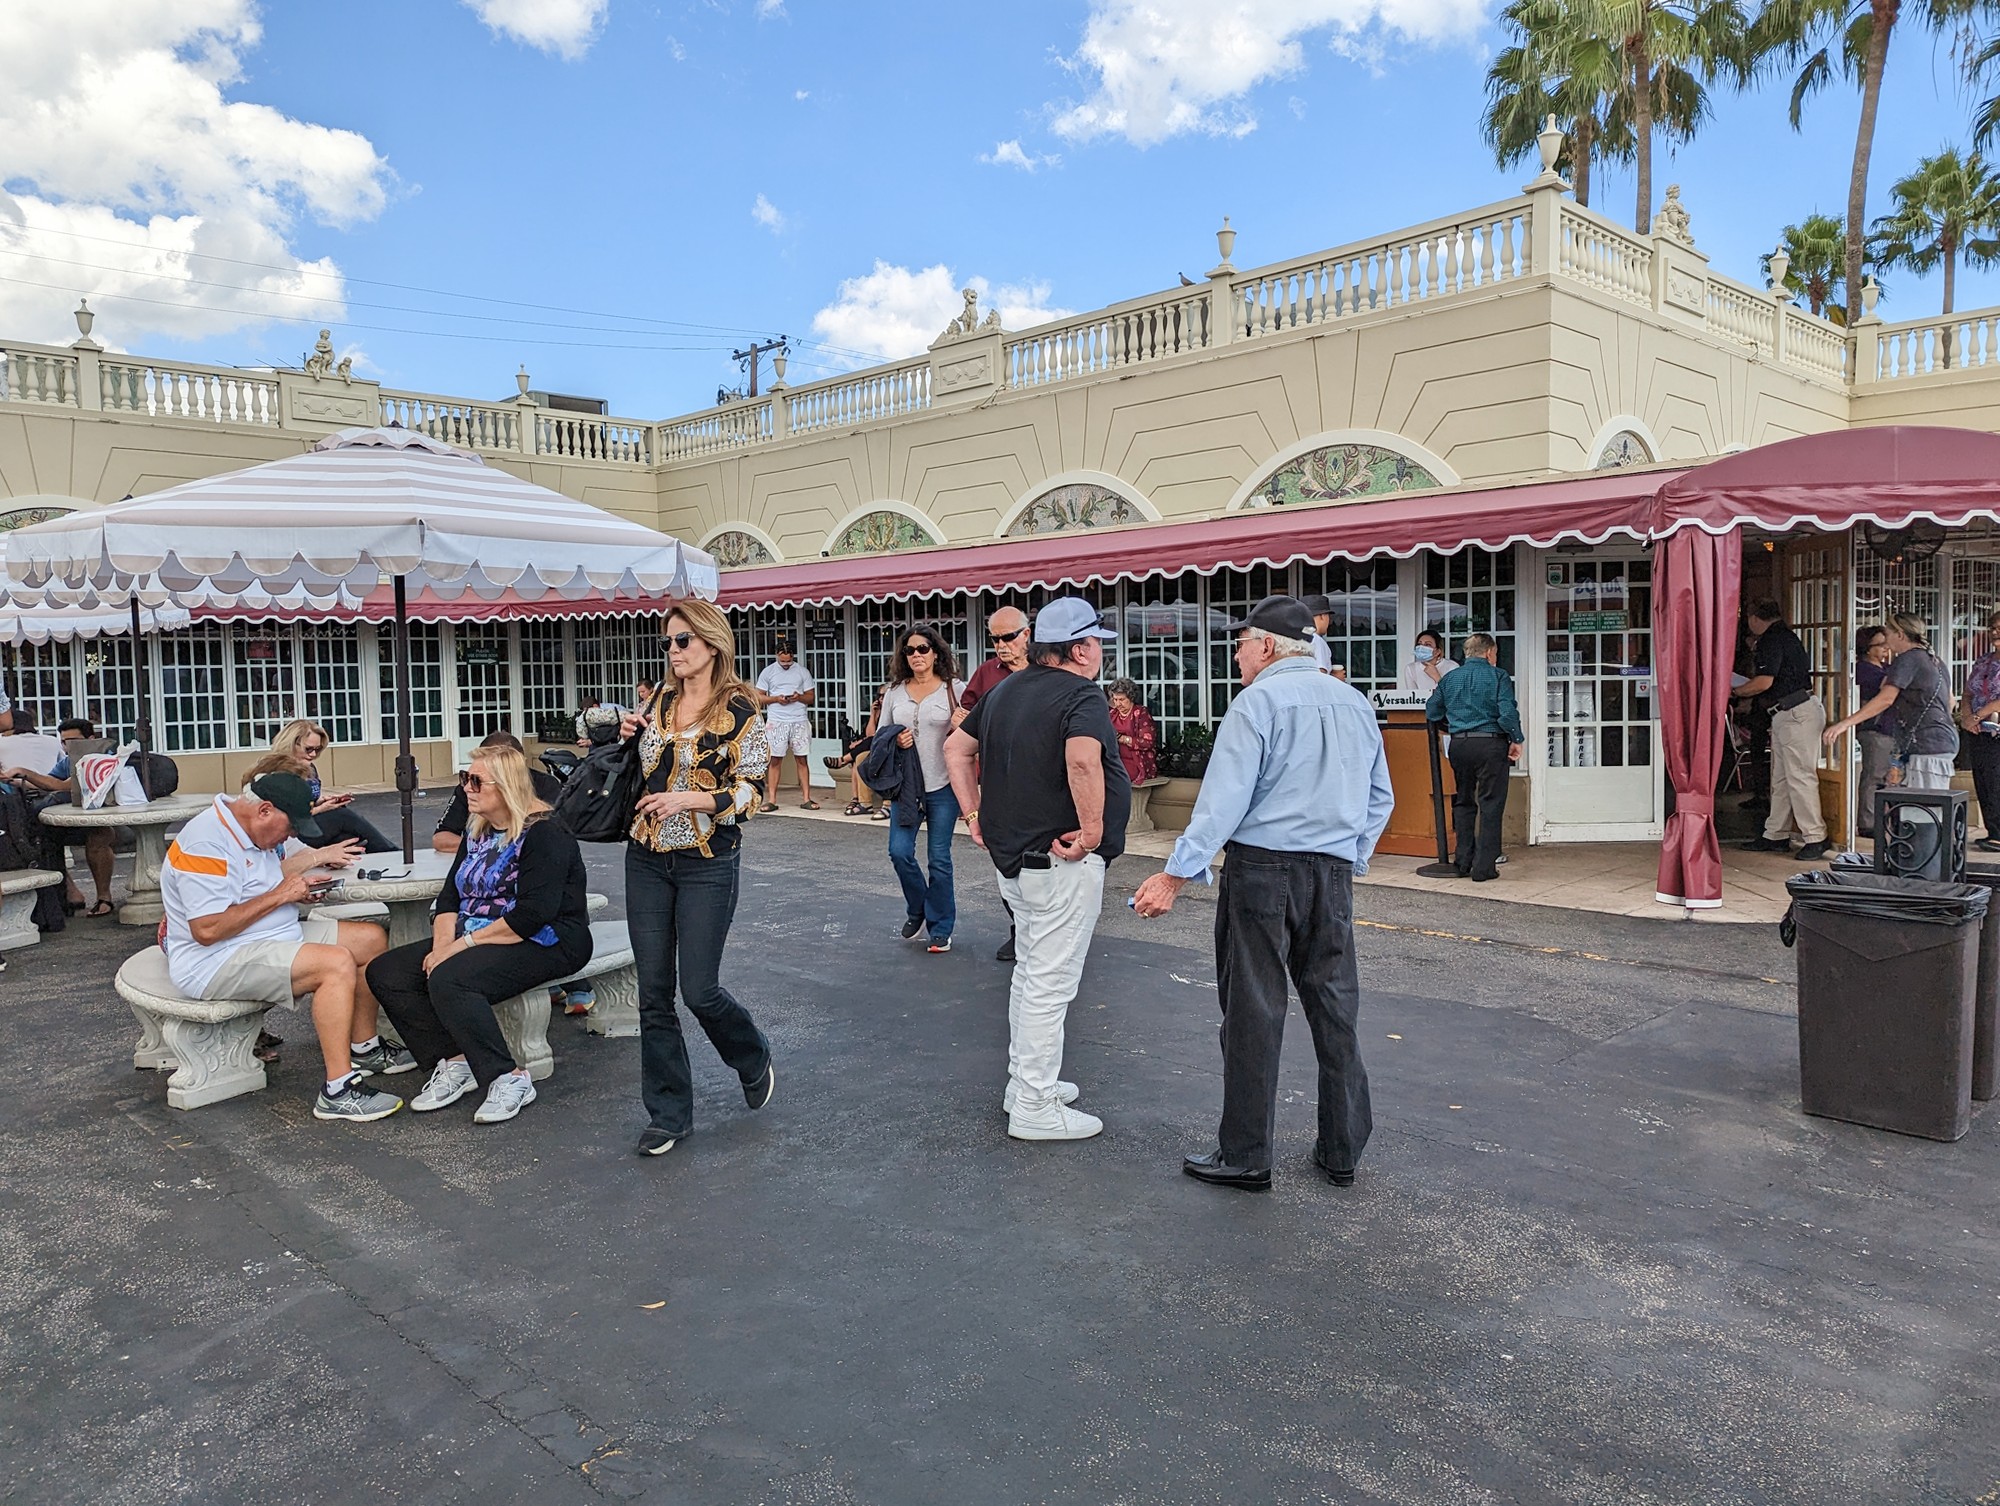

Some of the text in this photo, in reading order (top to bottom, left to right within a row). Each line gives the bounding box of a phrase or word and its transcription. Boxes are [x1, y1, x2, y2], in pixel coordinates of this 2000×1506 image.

[1547, 653, 1582, 663] UMBRELA
[1562, 667, 1579, 676] BG
[1373, 691, 1426, 708] Versailles
[1577, 727, 1585, 767] MBREL
